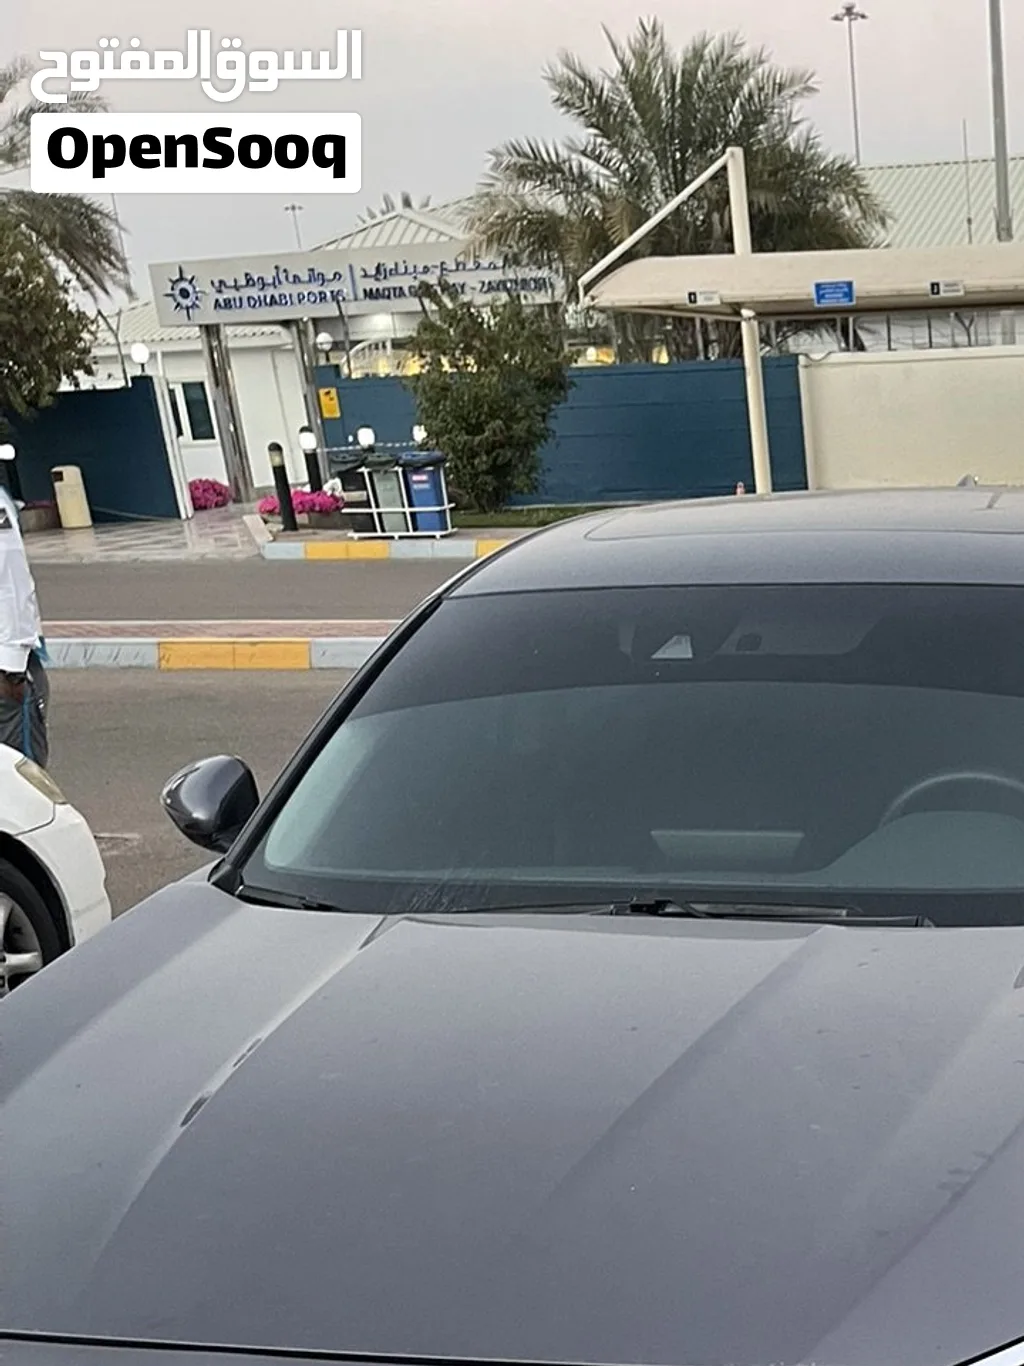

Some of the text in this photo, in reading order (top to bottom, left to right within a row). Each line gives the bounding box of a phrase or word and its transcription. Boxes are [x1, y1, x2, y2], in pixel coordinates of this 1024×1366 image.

[213, 288, 346, 310] ABU DHABI PORTS
[363, 285, 407, 300] MAQTA
